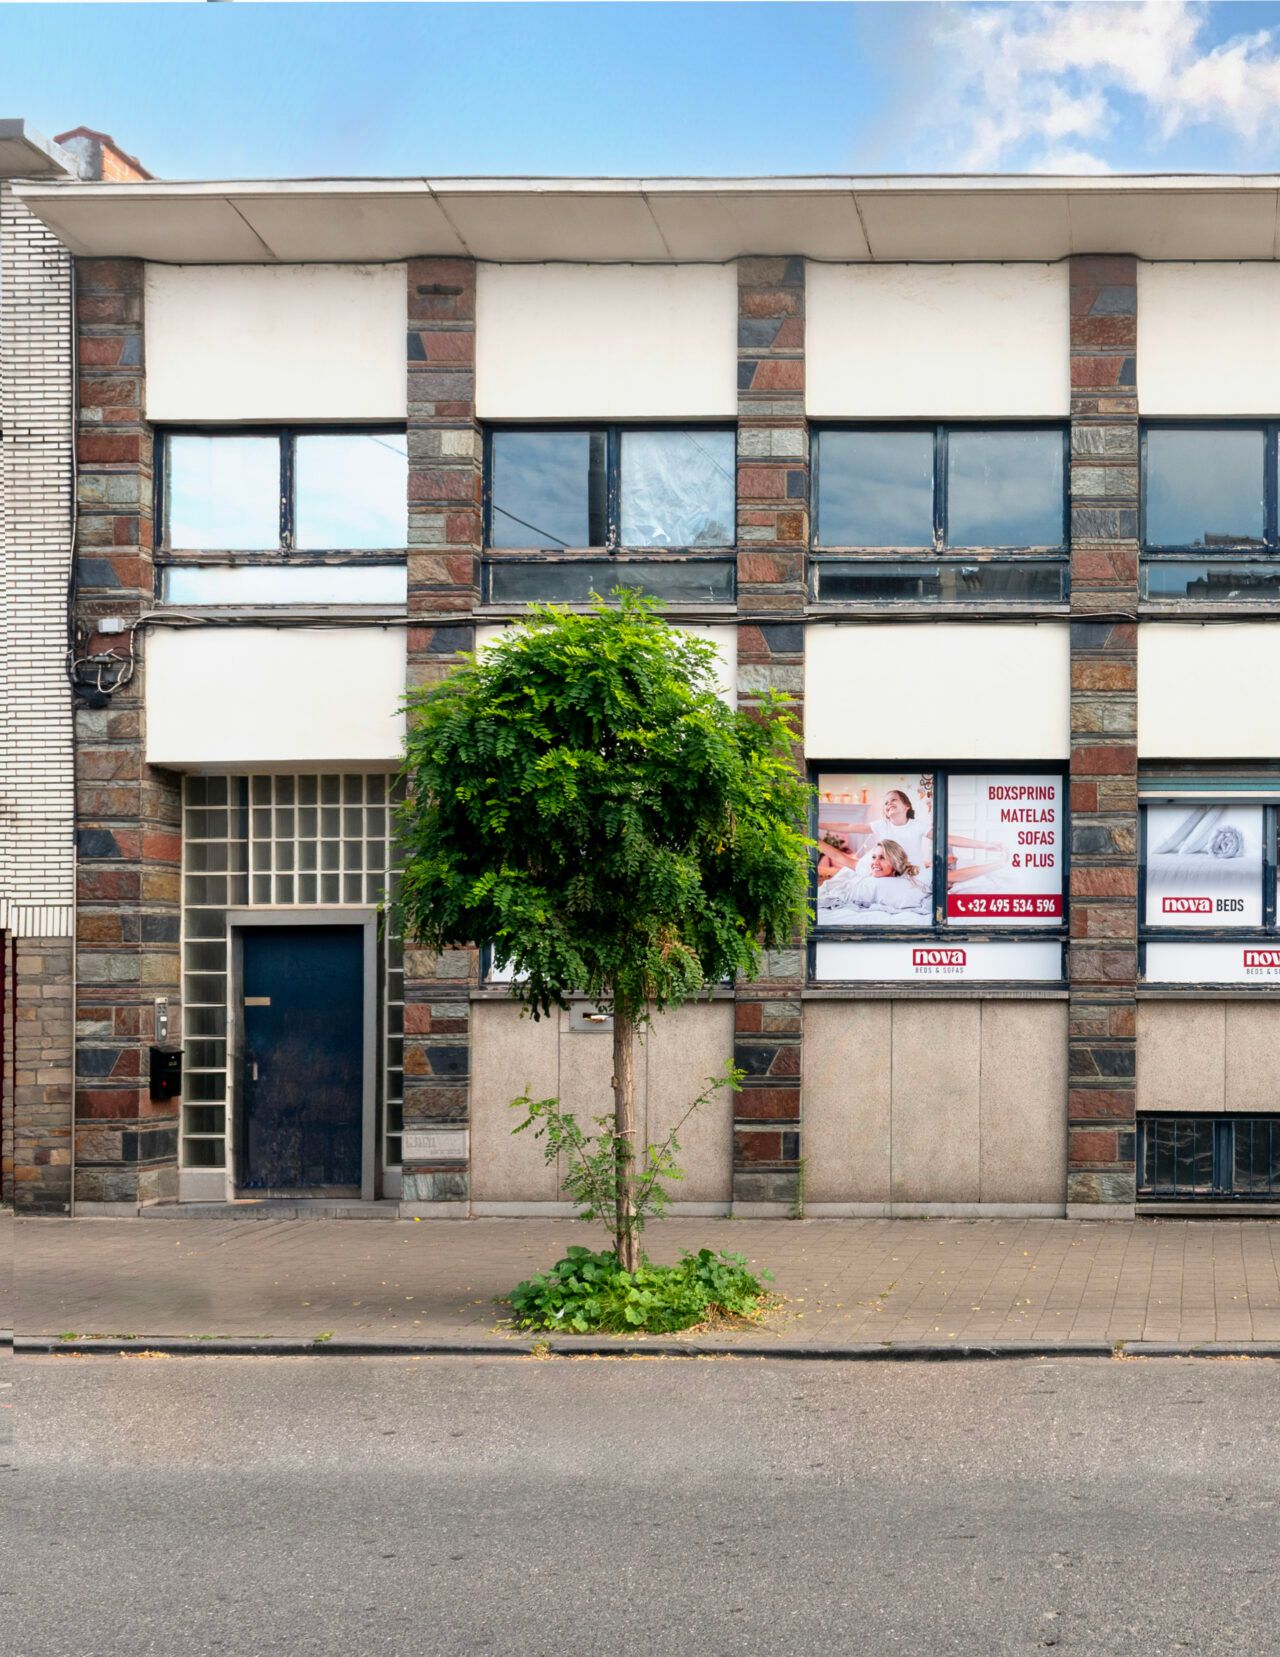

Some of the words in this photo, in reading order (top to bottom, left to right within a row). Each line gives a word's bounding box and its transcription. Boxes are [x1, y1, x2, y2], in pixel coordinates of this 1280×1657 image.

[988, 786, 1055, 801] BOXSPRING
[1001, 808, 1055, 823] MATELAS
[1017, 831, 1055, 845] SOFAS
[1011, 854, 1021, 867] &
[1025, 853, 1055, 867] PLUS
[968, 900, 987, 912] +32
[989, 900, 1010, 912] 495
[1013, 900, 1033, 912] 534
[1036, 900, 1055, 912] 596
[1164, 899, 1211, 912] nova
[1216, 899, 1244, 912] BEDS
[915, 951, 964, 964] nova
